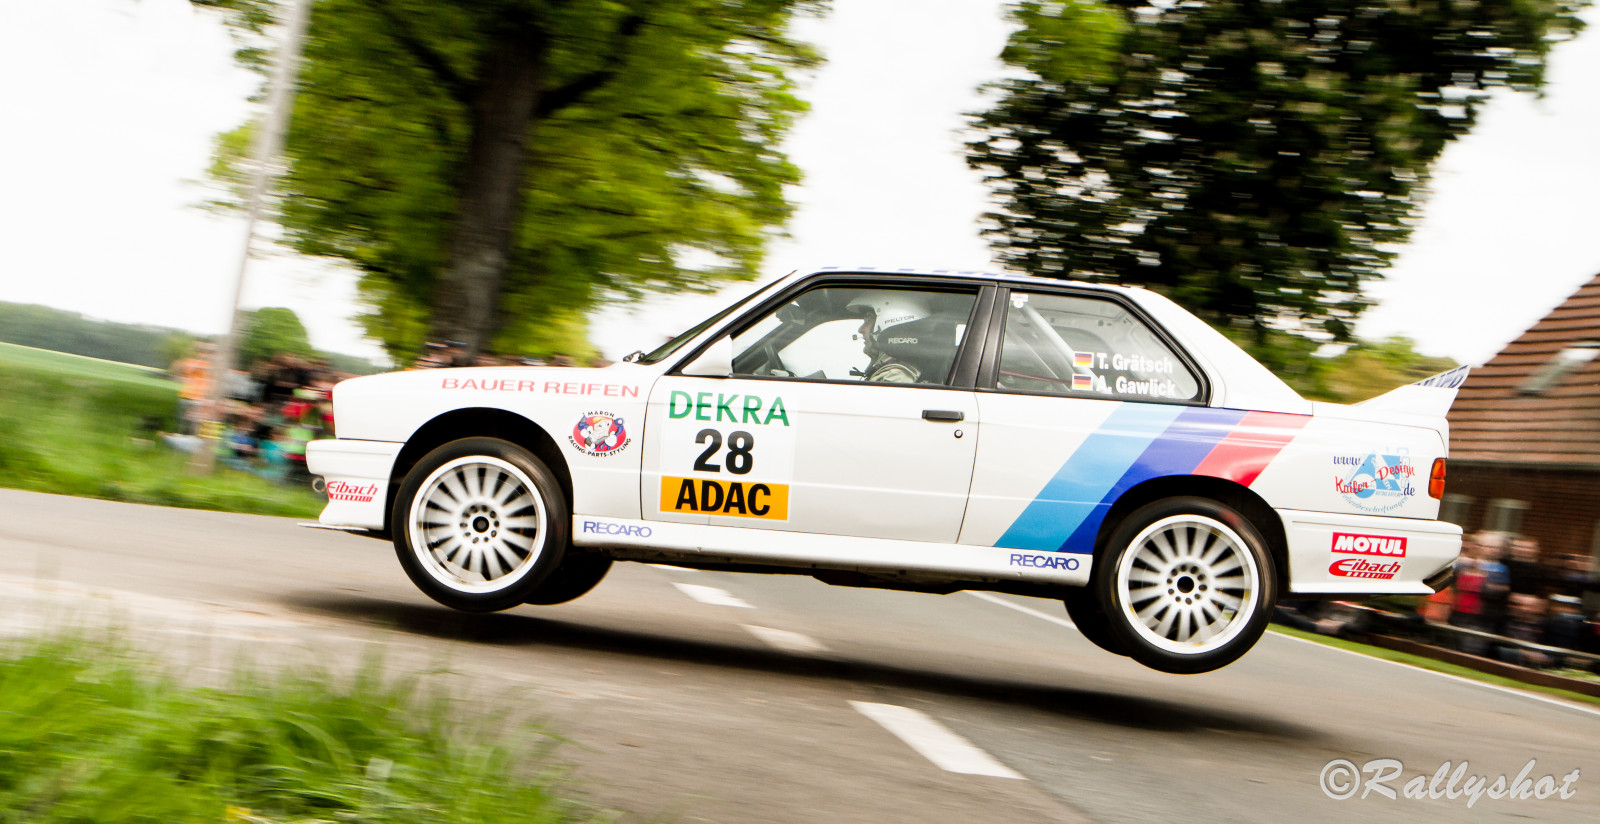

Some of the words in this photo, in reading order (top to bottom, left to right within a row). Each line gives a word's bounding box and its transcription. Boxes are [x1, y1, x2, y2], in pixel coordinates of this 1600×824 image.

[884, 315, 915, 324] PELTOR
[1096, 352, 1109, 370] T.
[1112, 353, 1173, 374] Grätsch
[441, 377, 535, 392] BAUER
[543, 382, 639, 398] REIFEN
[1096, 375, 1112, 394] A.
[668, 390, 790, 427] DEKRA
[693, 428, 754, 475] 28
[327, 481, 378, 499] Eibach
[674, 478, 772, 516] ADAC
[583, 521, 652, 538] RECARO
[1334, 535, 1404, 555] MOTUL
[1010, 553, 1080, 571] RECARO
[1329, 558, 1401, 577] Eibach
